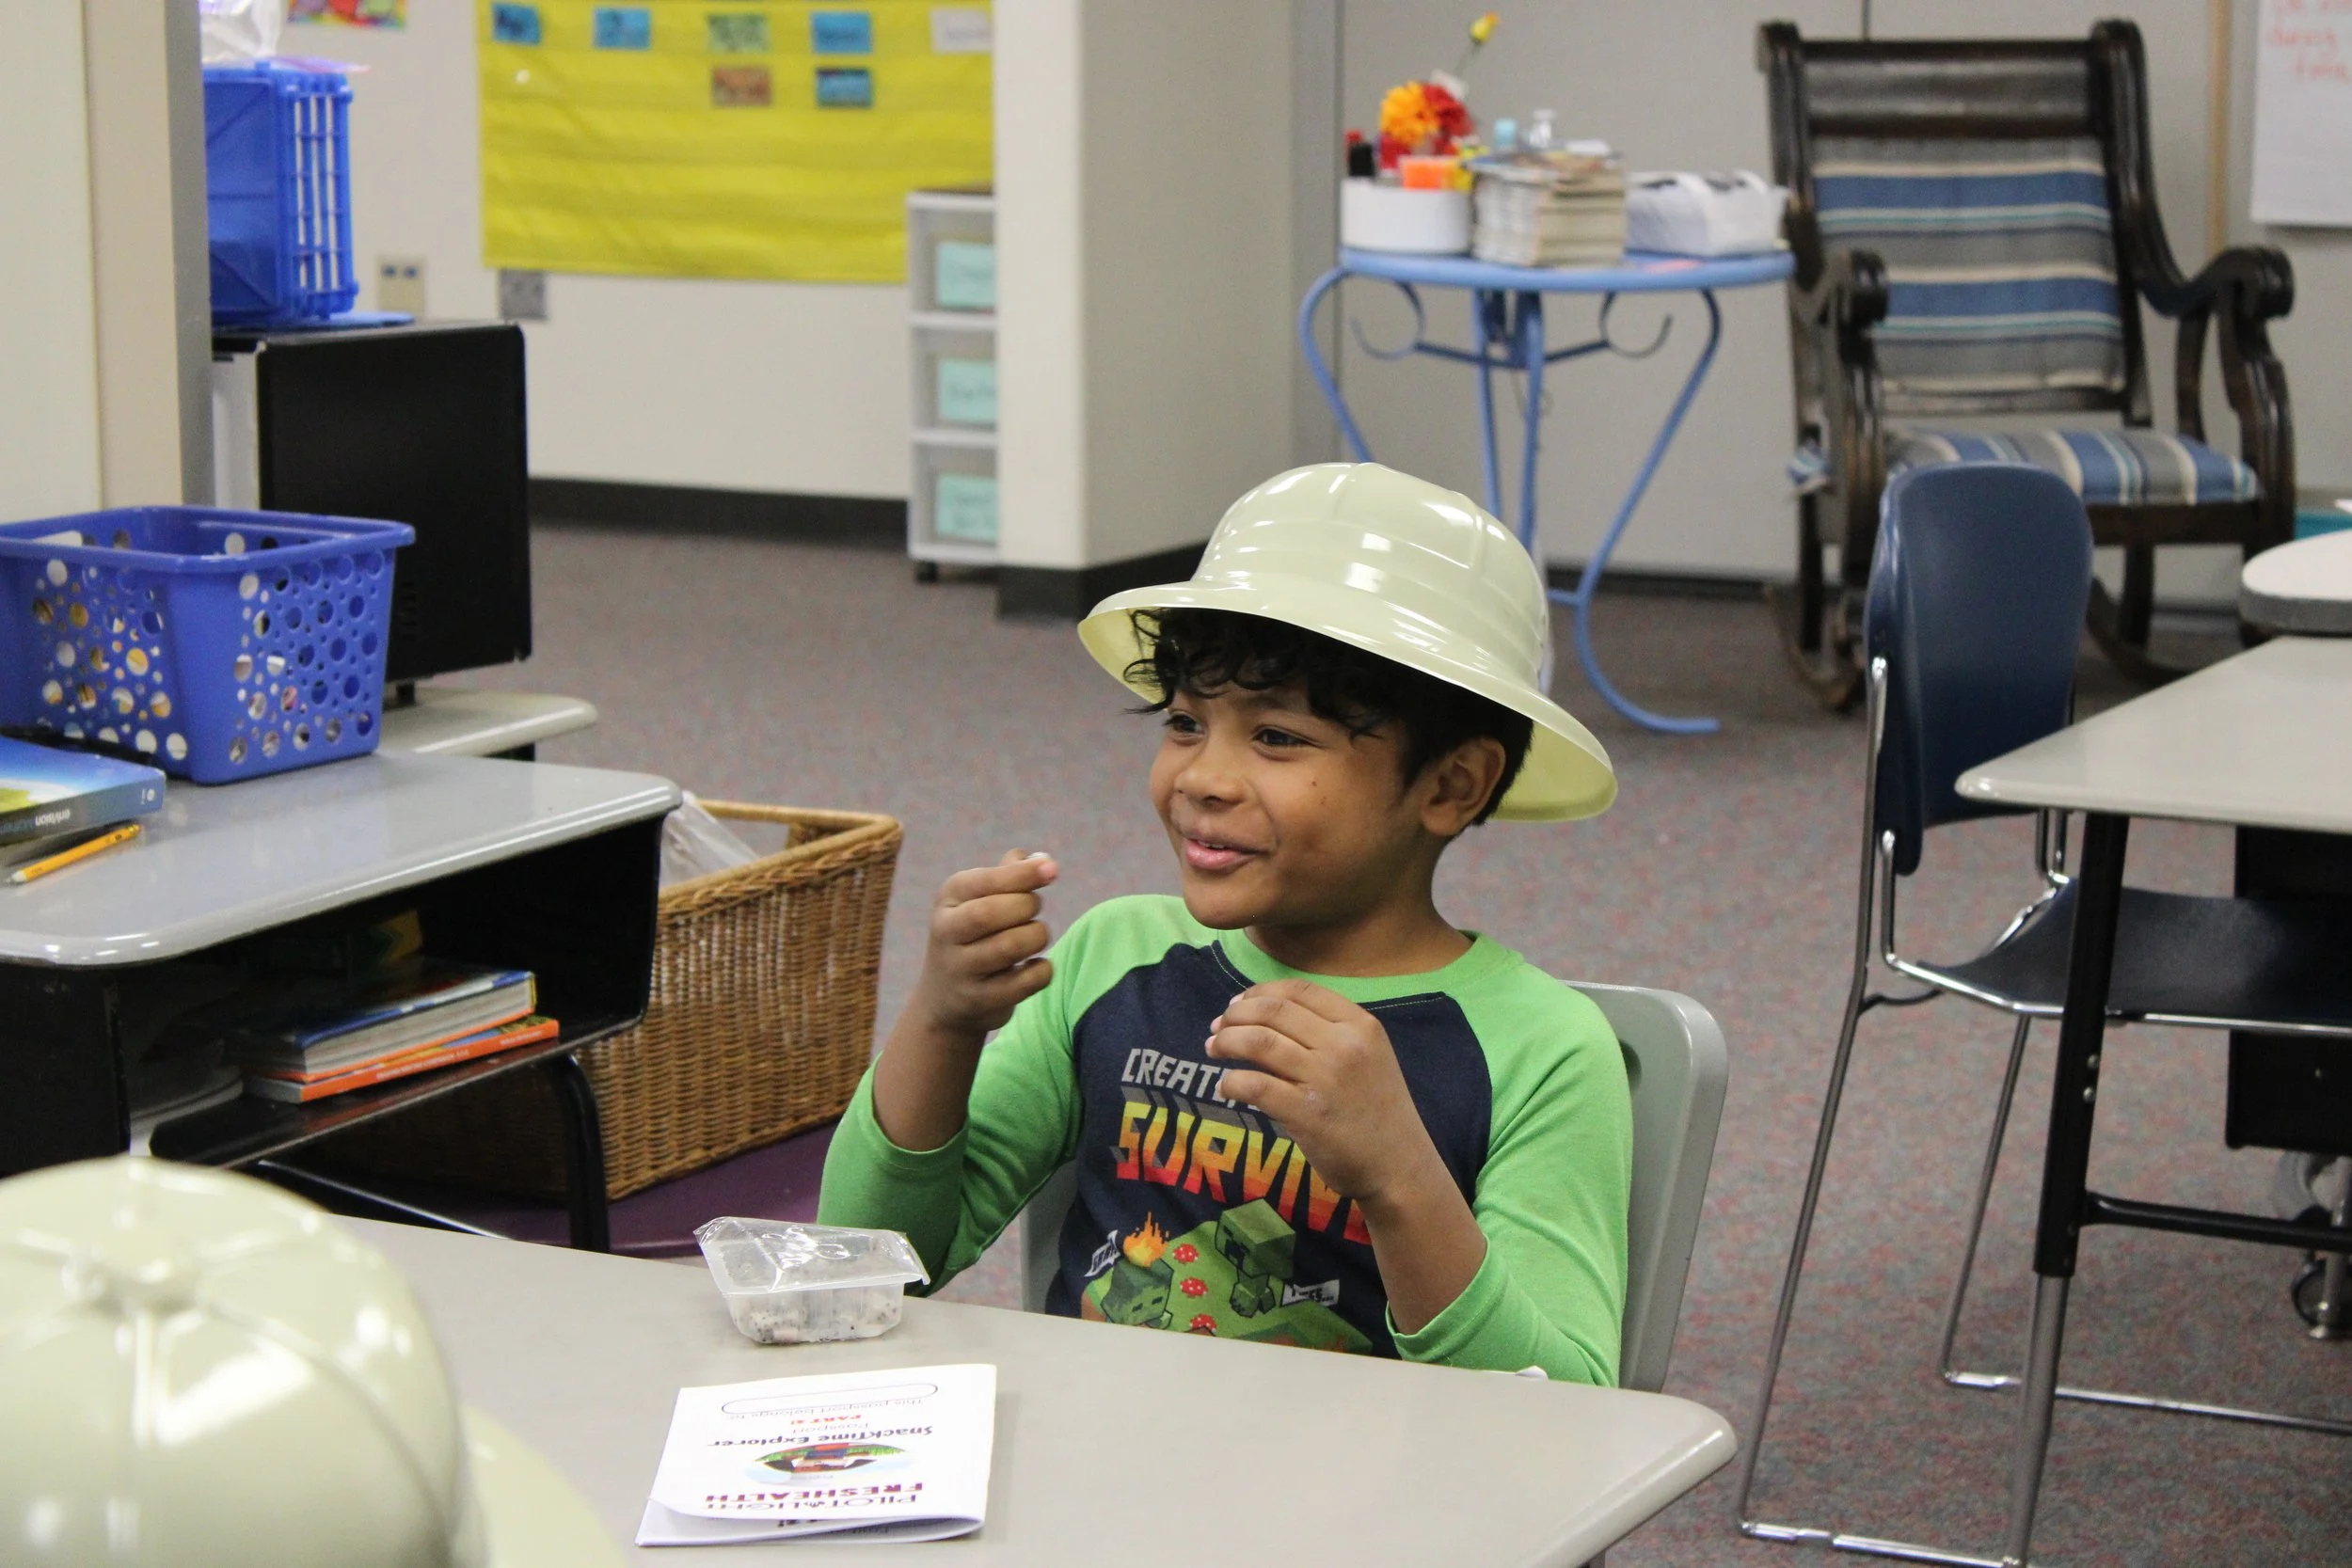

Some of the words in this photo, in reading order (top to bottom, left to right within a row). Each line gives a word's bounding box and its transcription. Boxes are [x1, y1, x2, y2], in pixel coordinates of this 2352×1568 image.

[820, 1400, 890, 1414] passport
[894, 1399, 923, 1407] This
[751, 1408, 815, 1418] belongs
[809, 1414, 862, 1424] PART
[792, 1422, 869, 1434] Passport
[817, 1425, 934, 1443] SnackTime
[707, 1435, 810, 1448] Explorer
[704, 1482, 923, 1503] FRESHEALTH
[703, 1501, 801, 1511] LIGHT
[825, 1494, 917, 1507] PILOT
